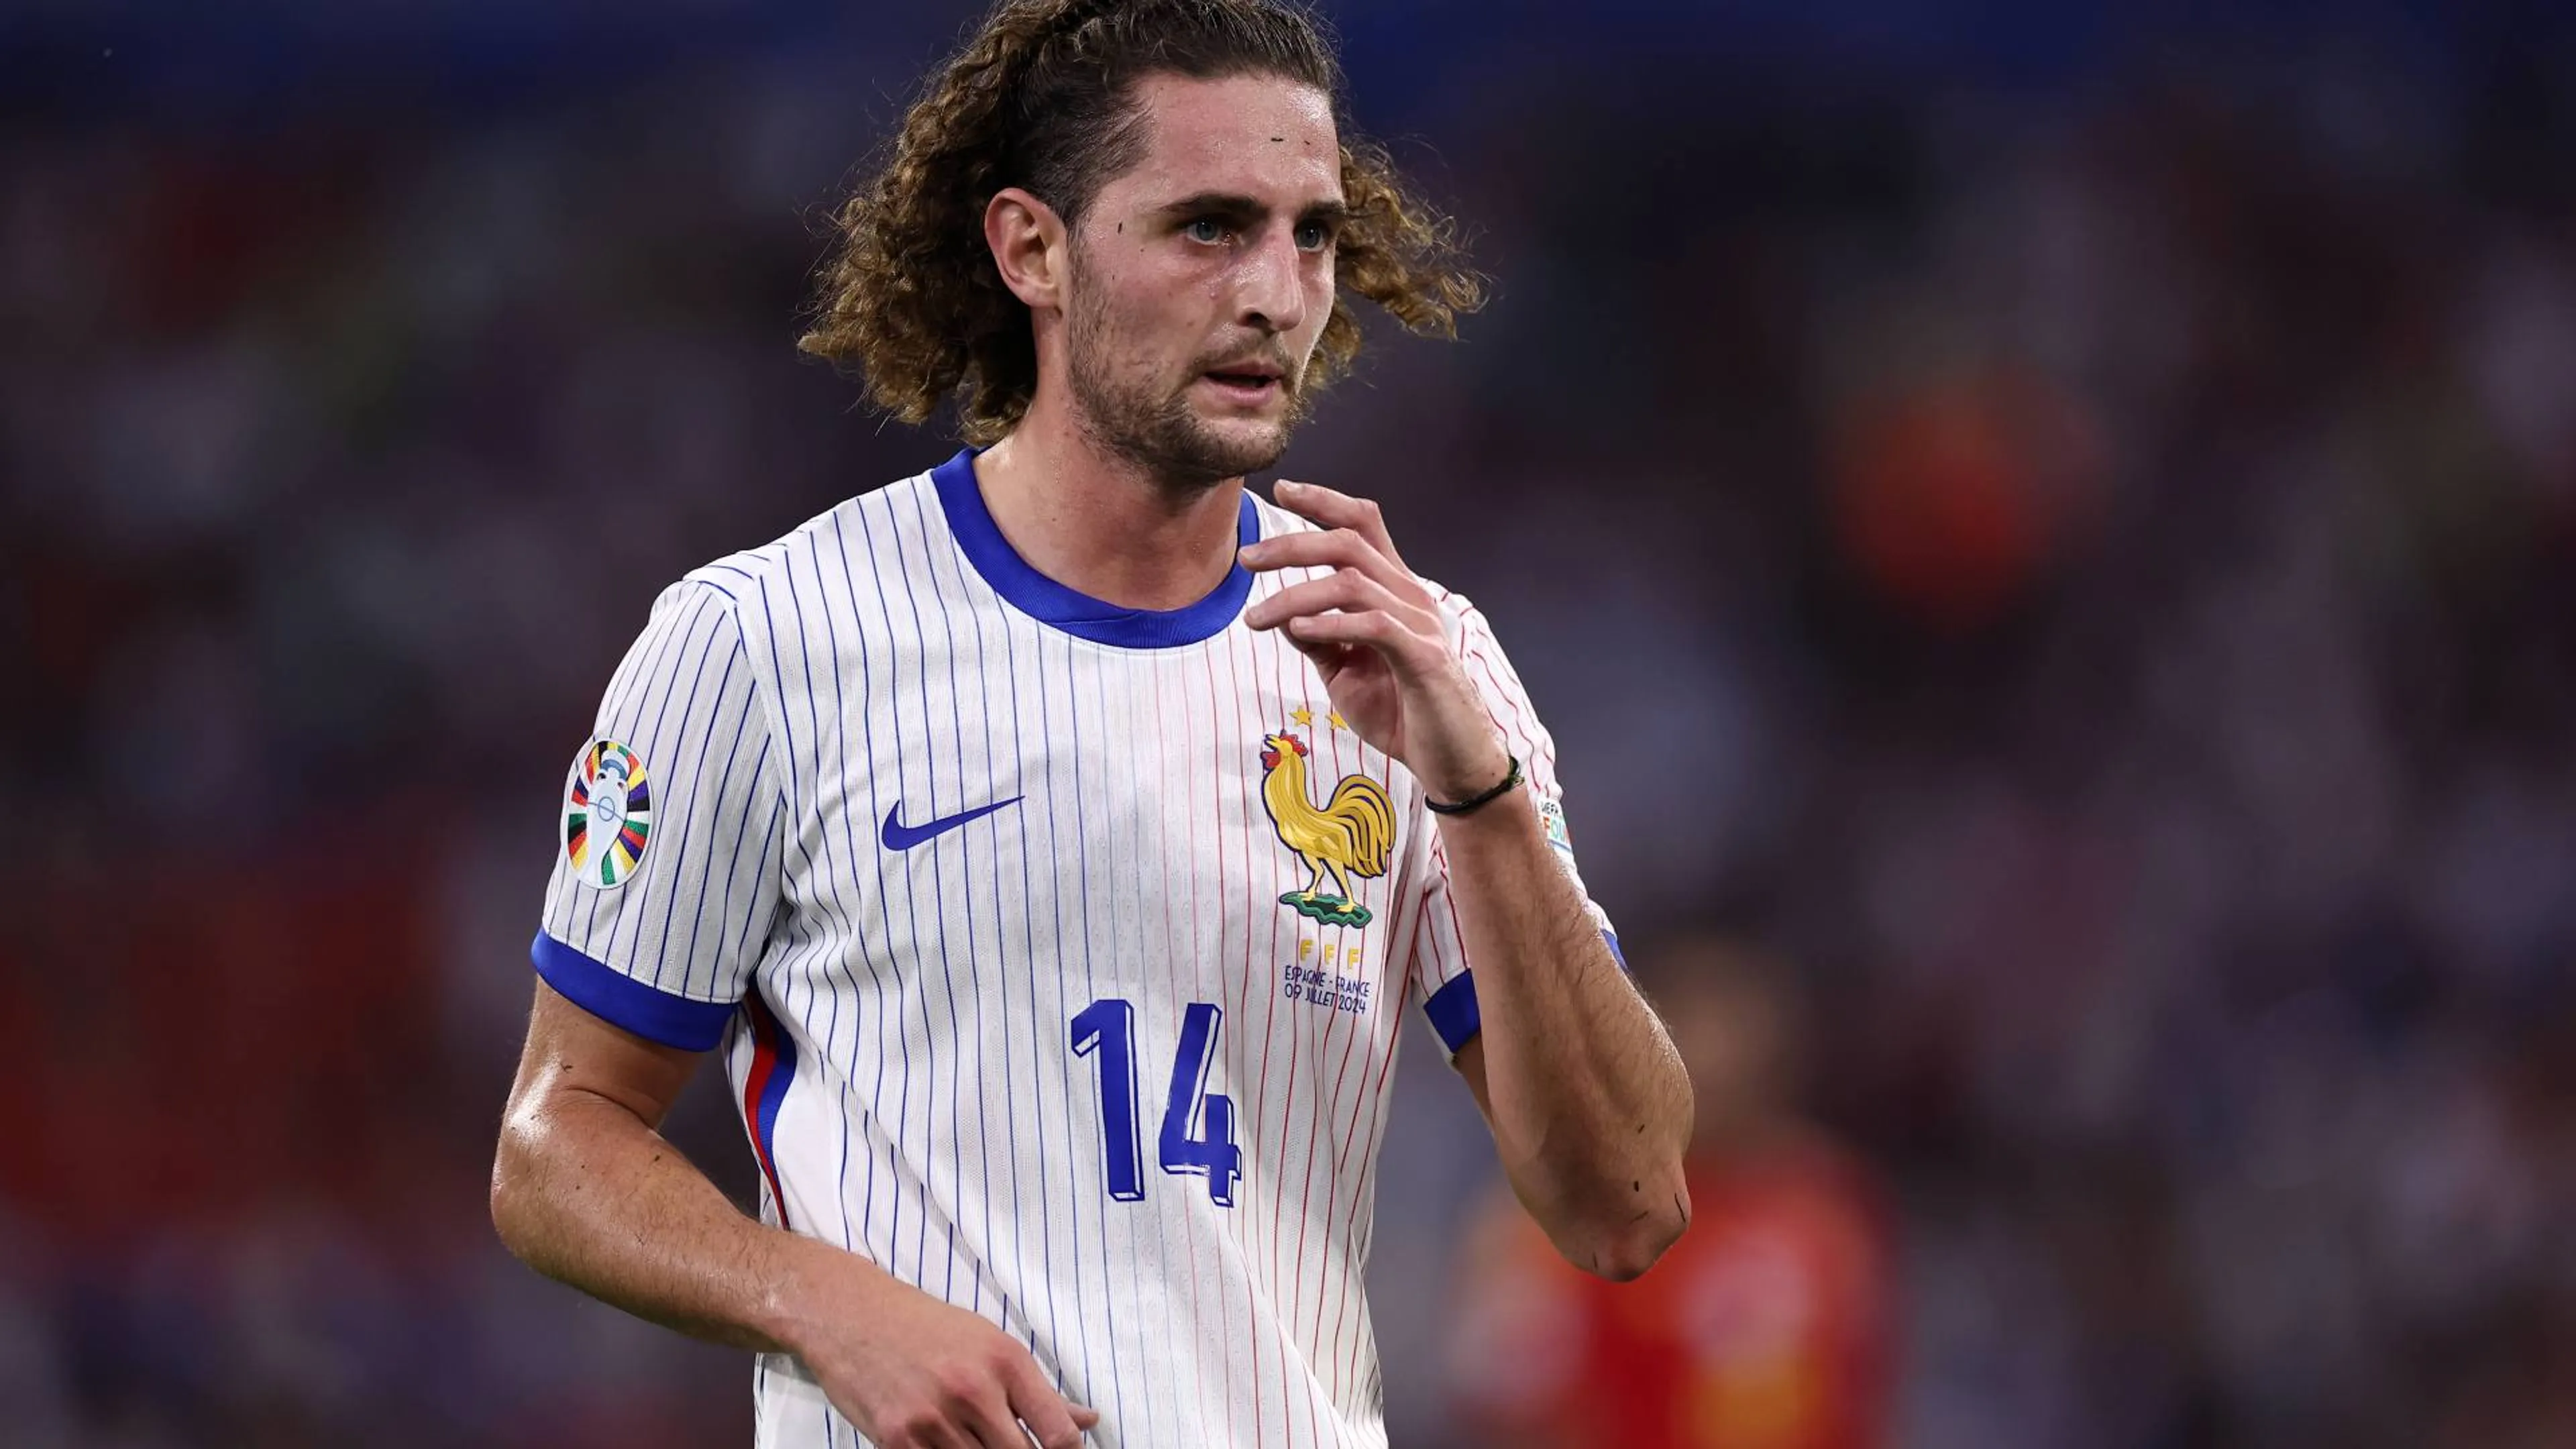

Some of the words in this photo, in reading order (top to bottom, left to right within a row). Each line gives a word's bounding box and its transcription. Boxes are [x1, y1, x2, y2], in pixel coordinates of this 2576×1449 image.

[1285, 965, 1326, 987] ESPAGNE
[1336, 976, 1370, 998] FRANCE
[1285, 983, 1302, 999] 09
[1338, 994, 1366, 1014] 2024
[1071, 999, 1242, 1208] 14
